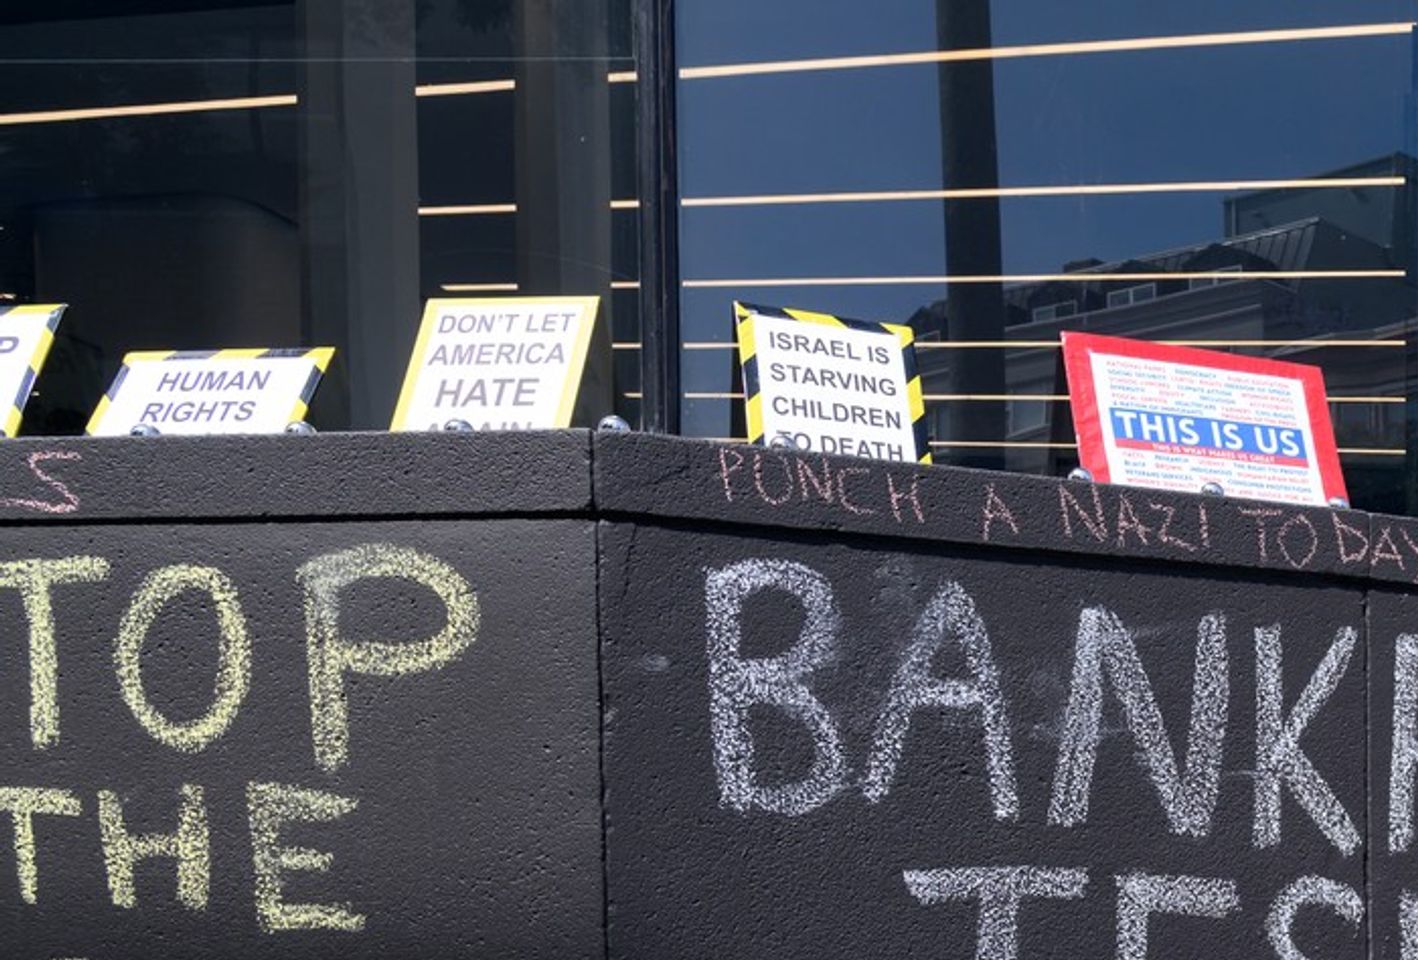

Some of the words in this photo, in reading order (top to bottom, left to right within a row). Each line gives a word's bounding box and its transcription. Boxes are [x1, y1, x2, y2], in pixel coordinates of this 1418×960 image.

[438, 314, 520, 333] DON'T
[525, 313, 576, 332] LET
[428, 343, 565, 366] AMERICA
[769, 331, 861, 360] ISRAEL
[868, 345, 890, 364] IS
[156, 370, 272, 391] HUMAN
[434, 378, 540, 407] HATE
[770, 362, 897, 396] STARVING
[139, 401, 256, 422] RIGHTS
[772, 396, 902, 429] CHILDREN
[776, 430, 812, 451] O
[820, 435, 904, 461] DEATH
[1115, 411, 1199, 446] THIS
[1210, 421, 1243, 450] IS
[1254, 426, 1300, 457] US
[719, 447, 925, 524] PUNCH
[982, 482, 1020, 541] A
[1057, 481, 1211, 553] NAZI
[0, 780, 367, 933] THE
